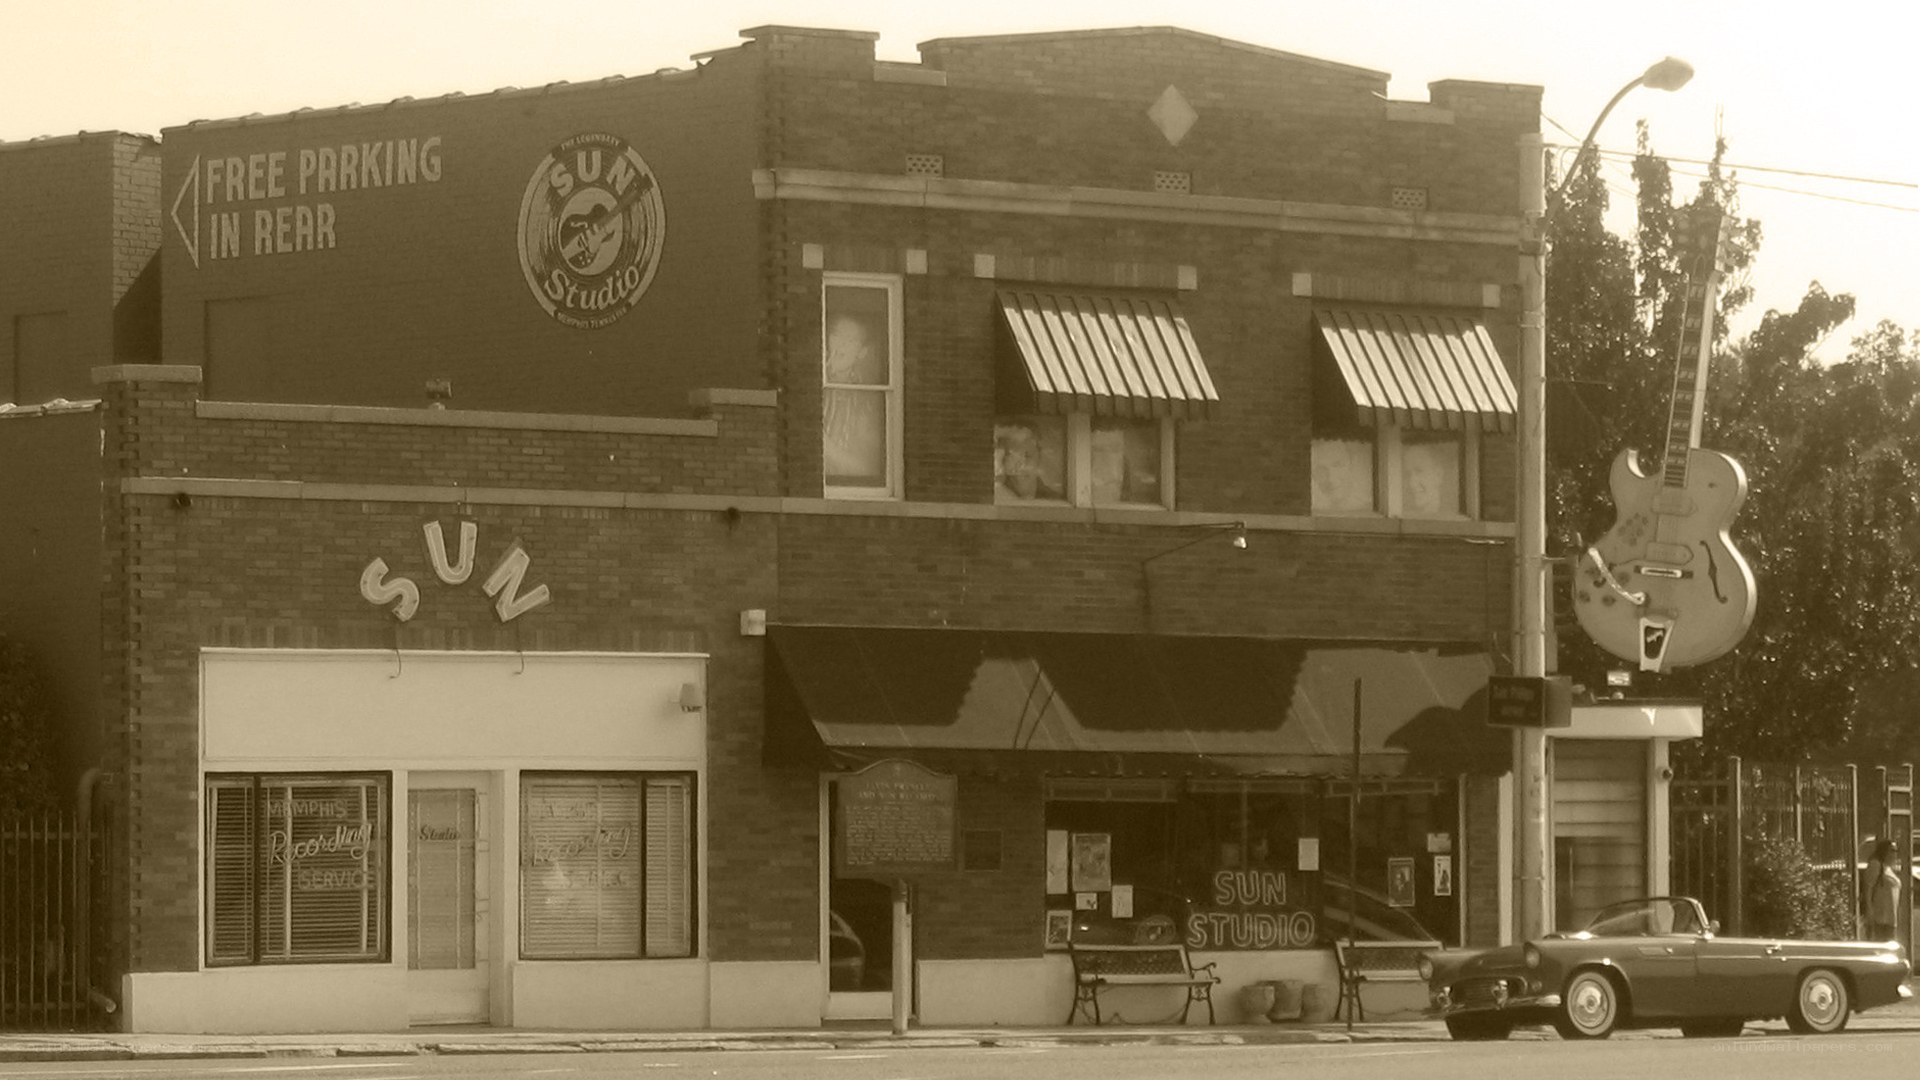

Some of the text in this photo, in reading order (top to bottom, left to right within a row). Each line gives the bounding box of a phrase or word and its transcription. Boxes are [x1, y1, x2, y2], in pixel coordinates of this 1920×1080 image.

[207, 136, 442, 204] FREE PARKING
[550, 150, 636, 198] SUN
[210, 203, 336, 259] IN REAR
[544, 266, 639, 310] Studio
[360, 520, 550, 622] SUN
[268, 799, 348, 819] MEMPHIS
[269, 823, 373, 864] Recording
[1214, 870, 1287, 905] SUN
[1186, 911, 1316, 948] STUDIO
